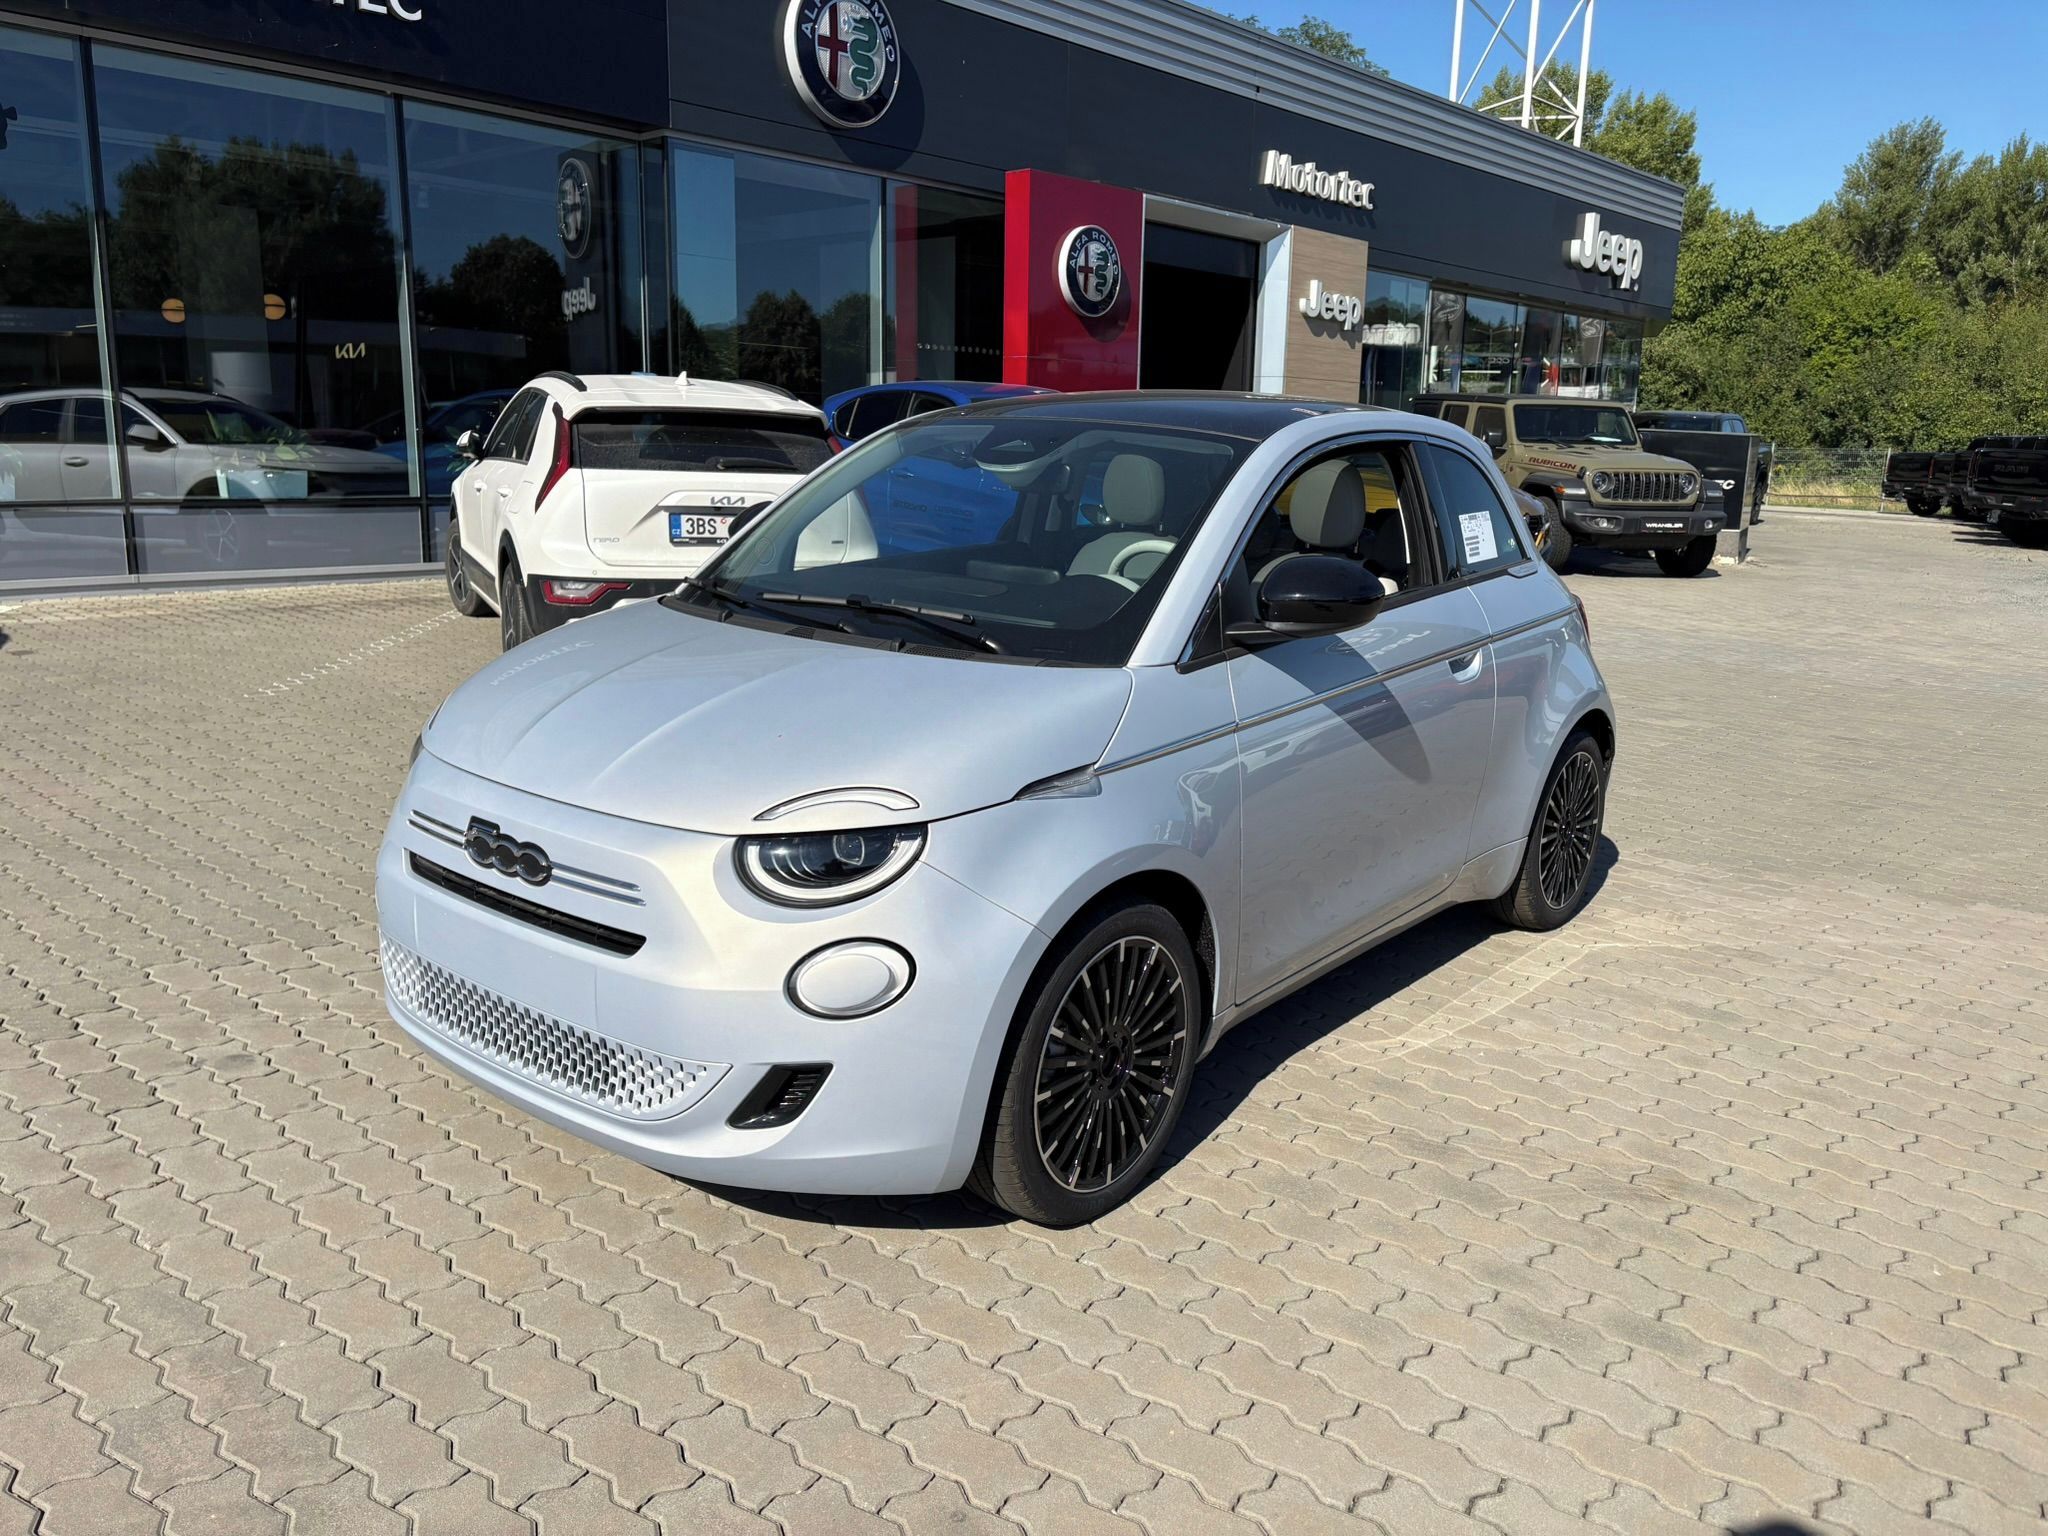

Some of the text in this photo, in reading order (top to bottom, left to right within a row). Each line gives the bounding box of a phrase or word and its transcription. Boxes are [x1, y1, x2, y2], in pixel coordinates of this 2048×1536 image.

[1261, 150, 1375, 210] Motortec
[1070, 231, 1119, 275] ALFA ROMEO
[1568, 212, 1643, 290] Jeep
[1299, 279, 1361, 331] Jeep
[335, 342, 366, 359] KIA
[1528, 456, 1577, 471] RUBICON
[710, 496, 746, 506] KIA
[671, 528, 681, 536] CZ
[685, 517, 717, 536] 3BS
[464, 815, 553, 888] 500
